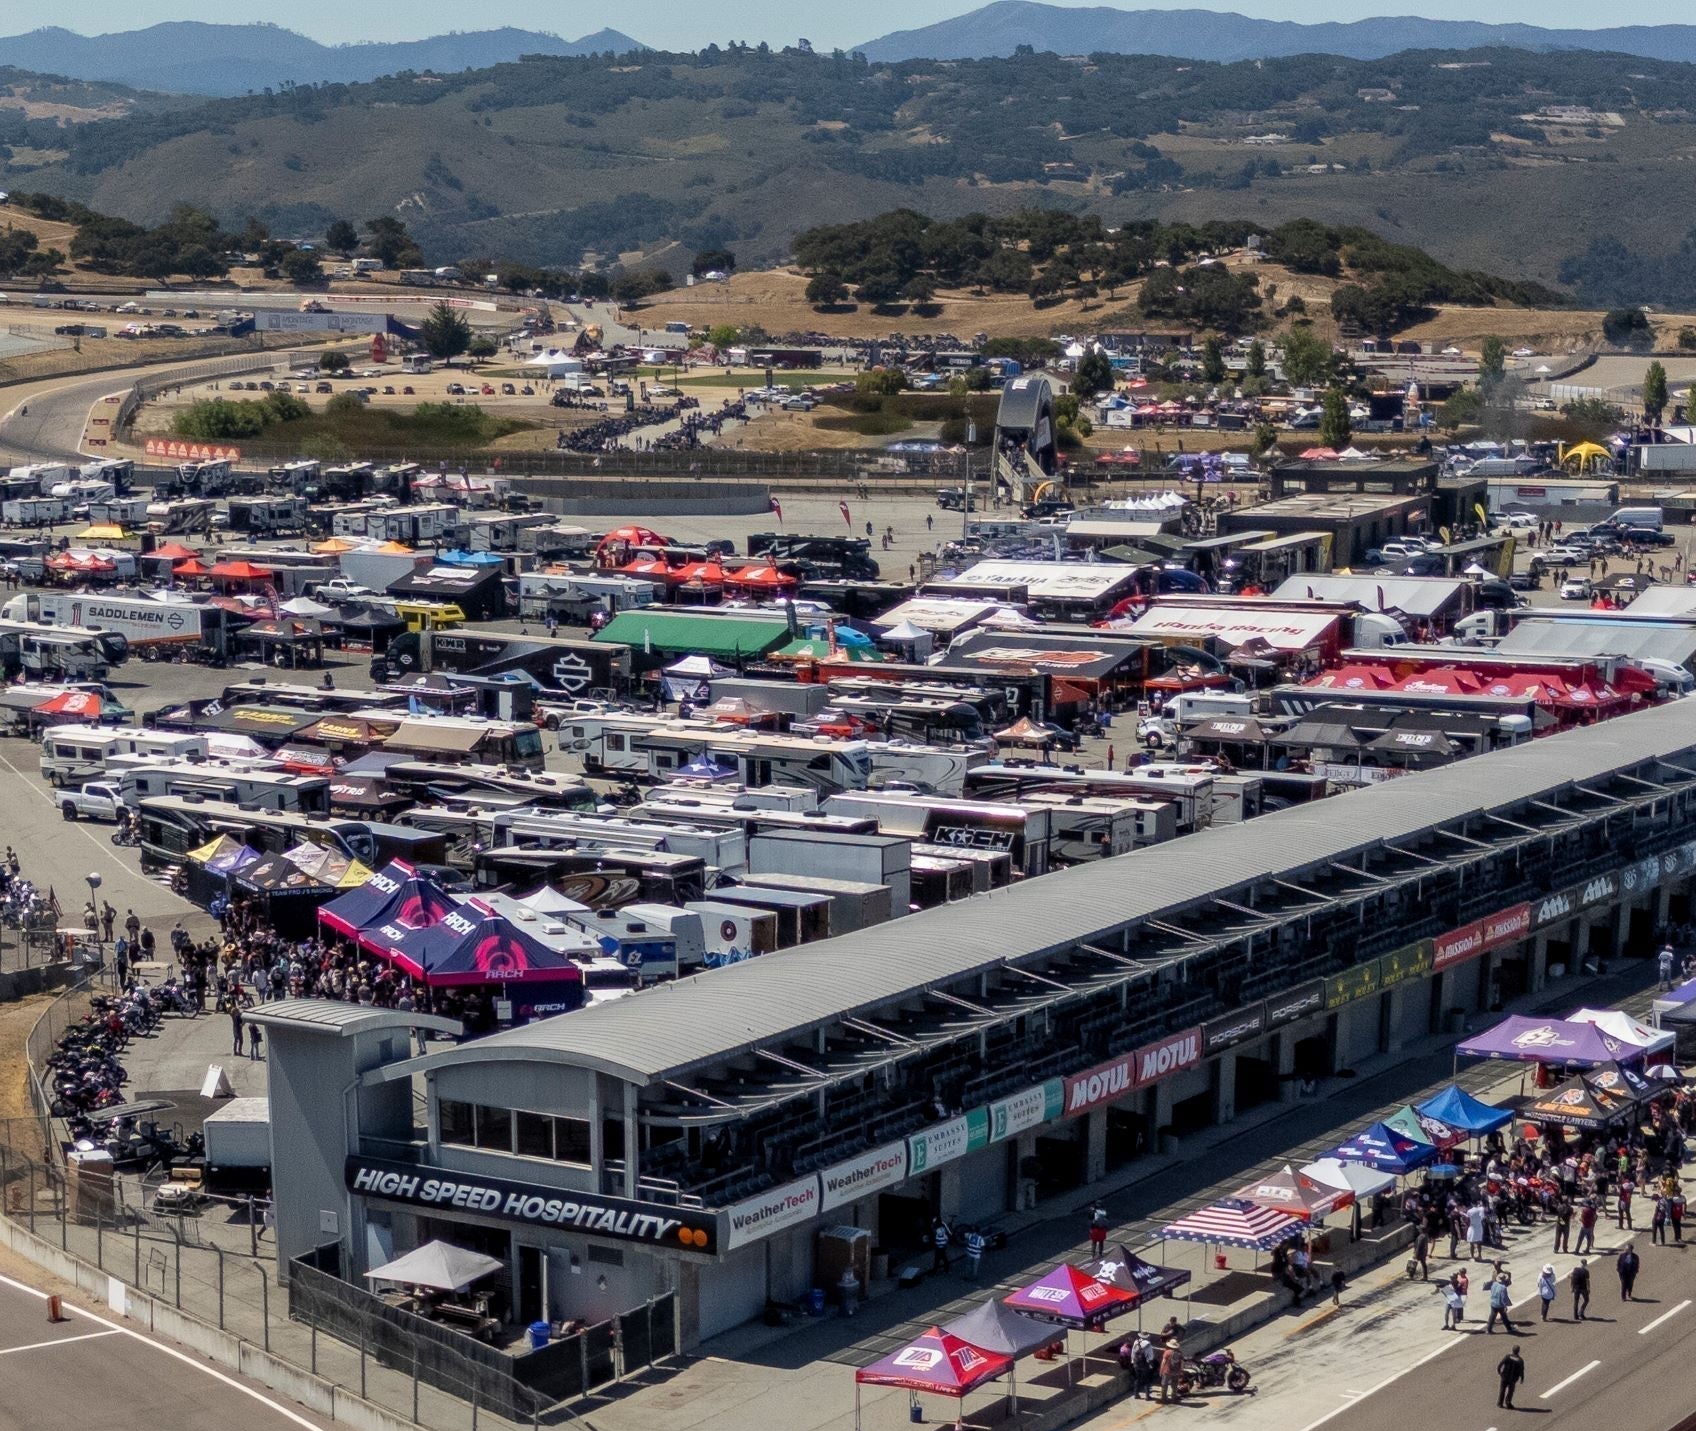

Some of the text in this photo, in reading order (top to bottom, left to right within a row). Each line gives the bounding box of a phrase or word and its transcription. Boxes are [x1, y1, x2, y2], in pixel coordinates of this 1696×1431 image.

[88, 607, 165, 623] SADDLEMEN
[367, 872, 400, 895] ARCH
[380, 924, 403, 941] ARCH
[442, 911, 476, 936] ARCH
[484, 969, 525, 979] ARCH
[533, 1003, 566, 1013] ARCH
[1271, 993, 1321, 1021] PORSCHE
[1208, 1017, 1261, 1046] PORSCHE
[1139, 1035, 1198, 1081] MOTUL
[1069, 1062, 1130, 1111] MOTUL
[1008, 1091, 1043, 1112] EMBASSY
[928, 1123, 967, 1144] EMBASSY
[826, 1152, 903, 1193] WeatherTech
[353, 1167, 678, 1240] HIGH SPEED HOSPITALITY
[732, 1187, 815, 1231] WeatherTech
